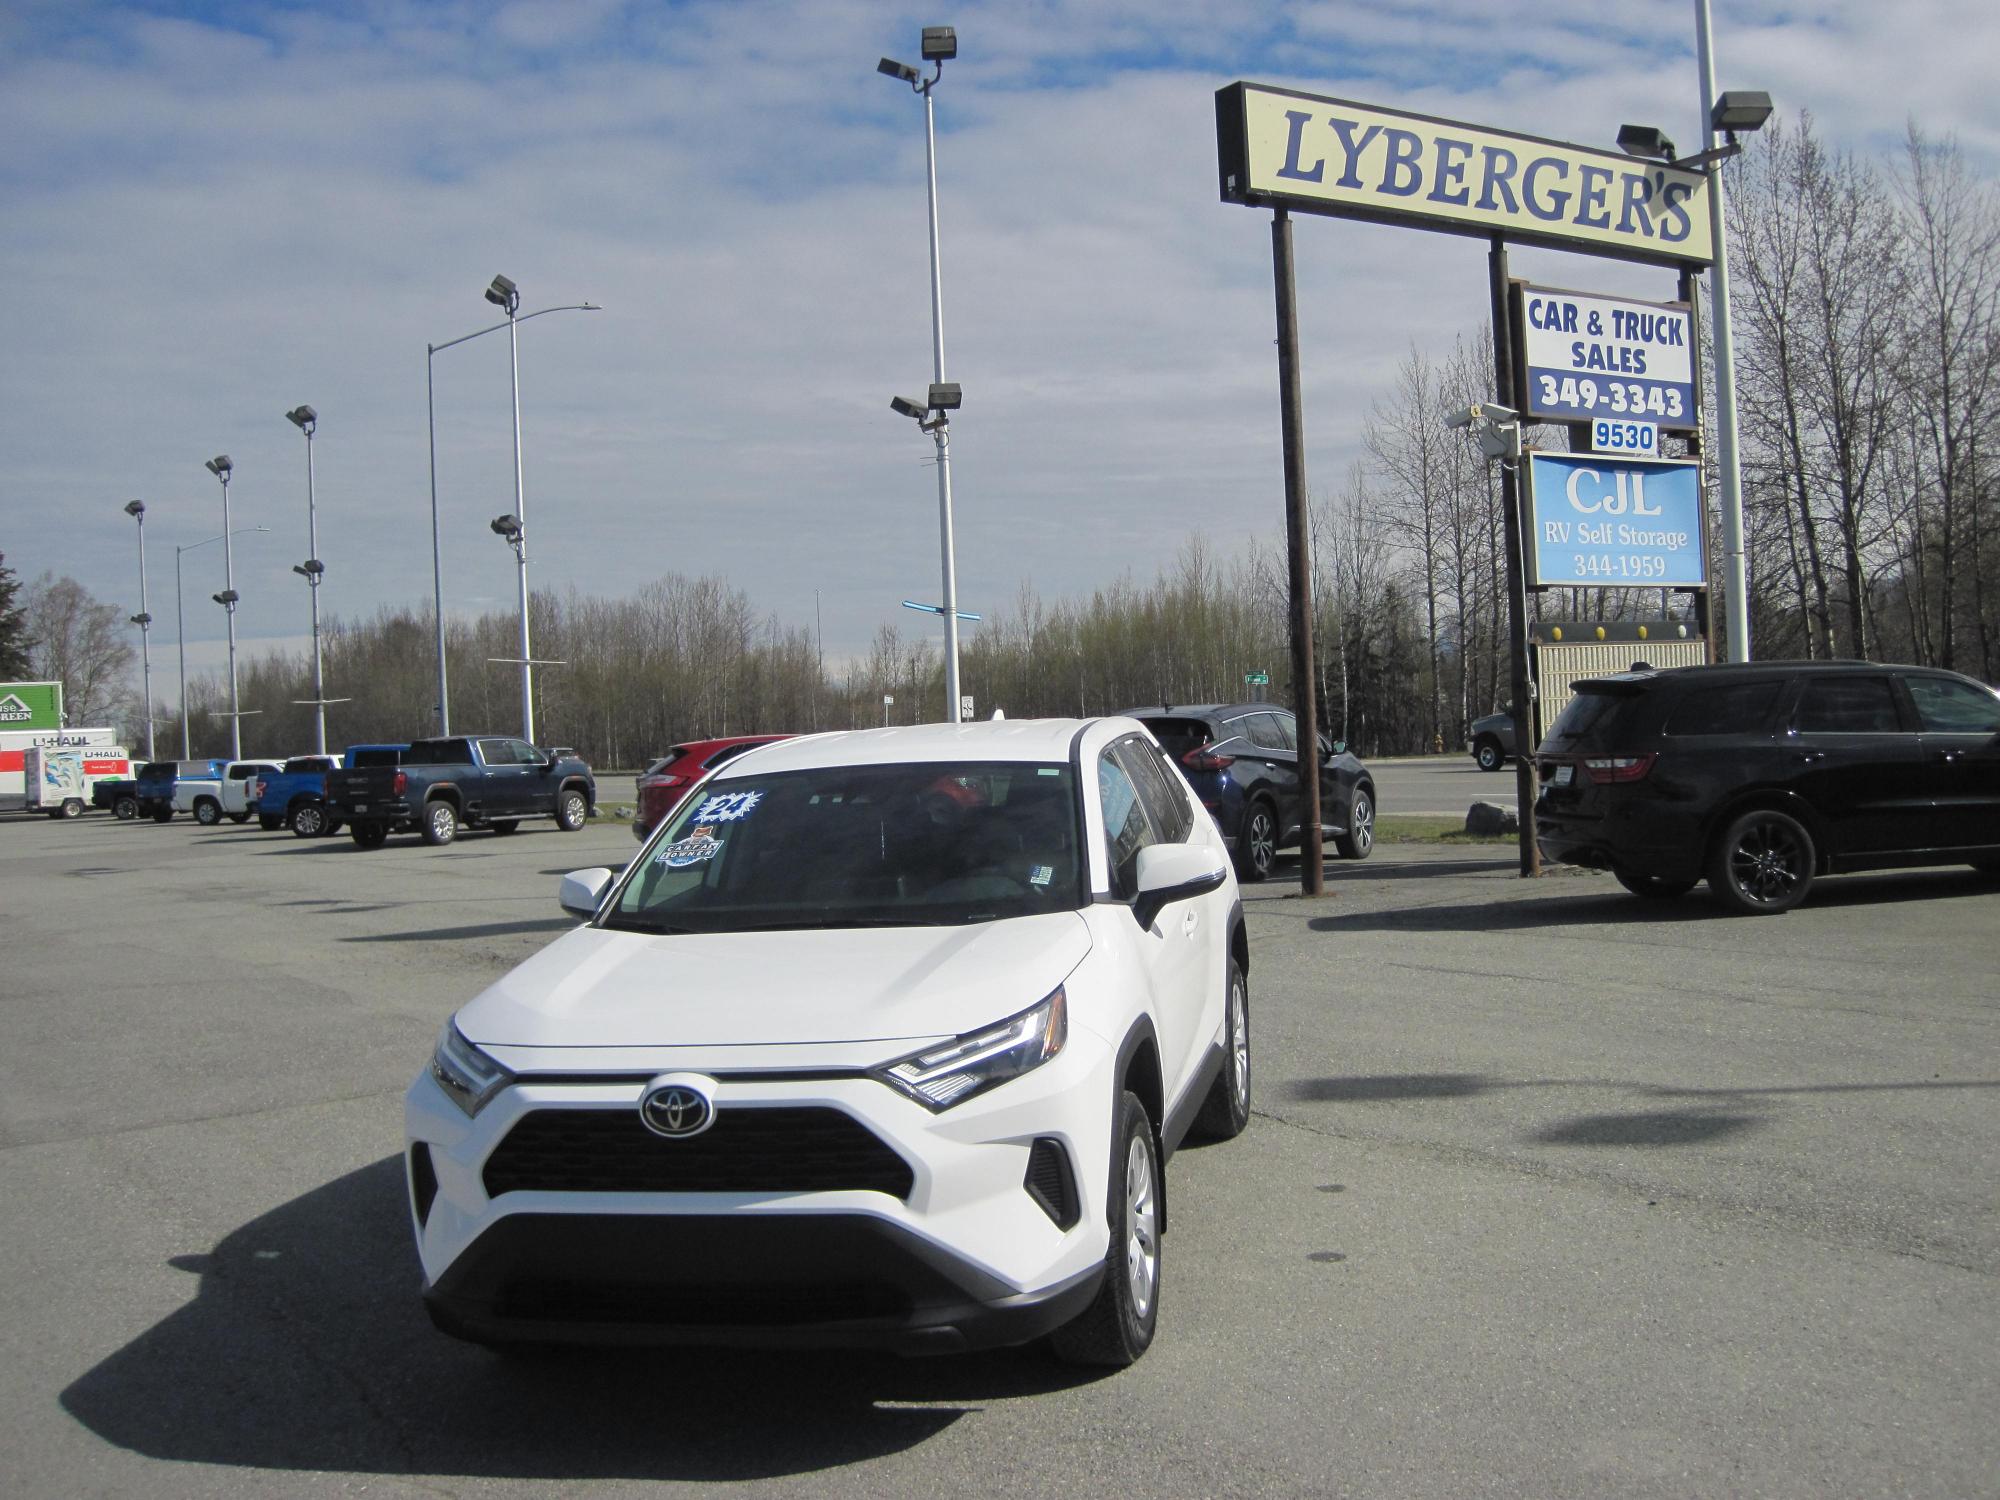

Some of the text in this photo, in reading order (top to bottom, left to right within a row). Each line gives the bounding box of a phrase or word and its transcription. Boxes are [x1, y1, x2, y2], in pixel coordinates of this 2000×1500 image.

[1277, 110, 1692, 242] LYBERGER'S
[1529, 299, 1683, 346] CAR & TRUCK
[1572, 342, 1646, 374] SALES
[1540, 375, 1683, 417] 349-3343
[1596, 423, 1653, 449] 9530
[1567, 468, 1661, 515] CJL
[1545, 521, 1687, 550] RV Self Storage
[1575, 555, 1665, 577] 344-1959
[0, 712, 32, 720] REEN
[33, 736, 91, 746] U-HAUL
[705, 797, 748, 816] 24
